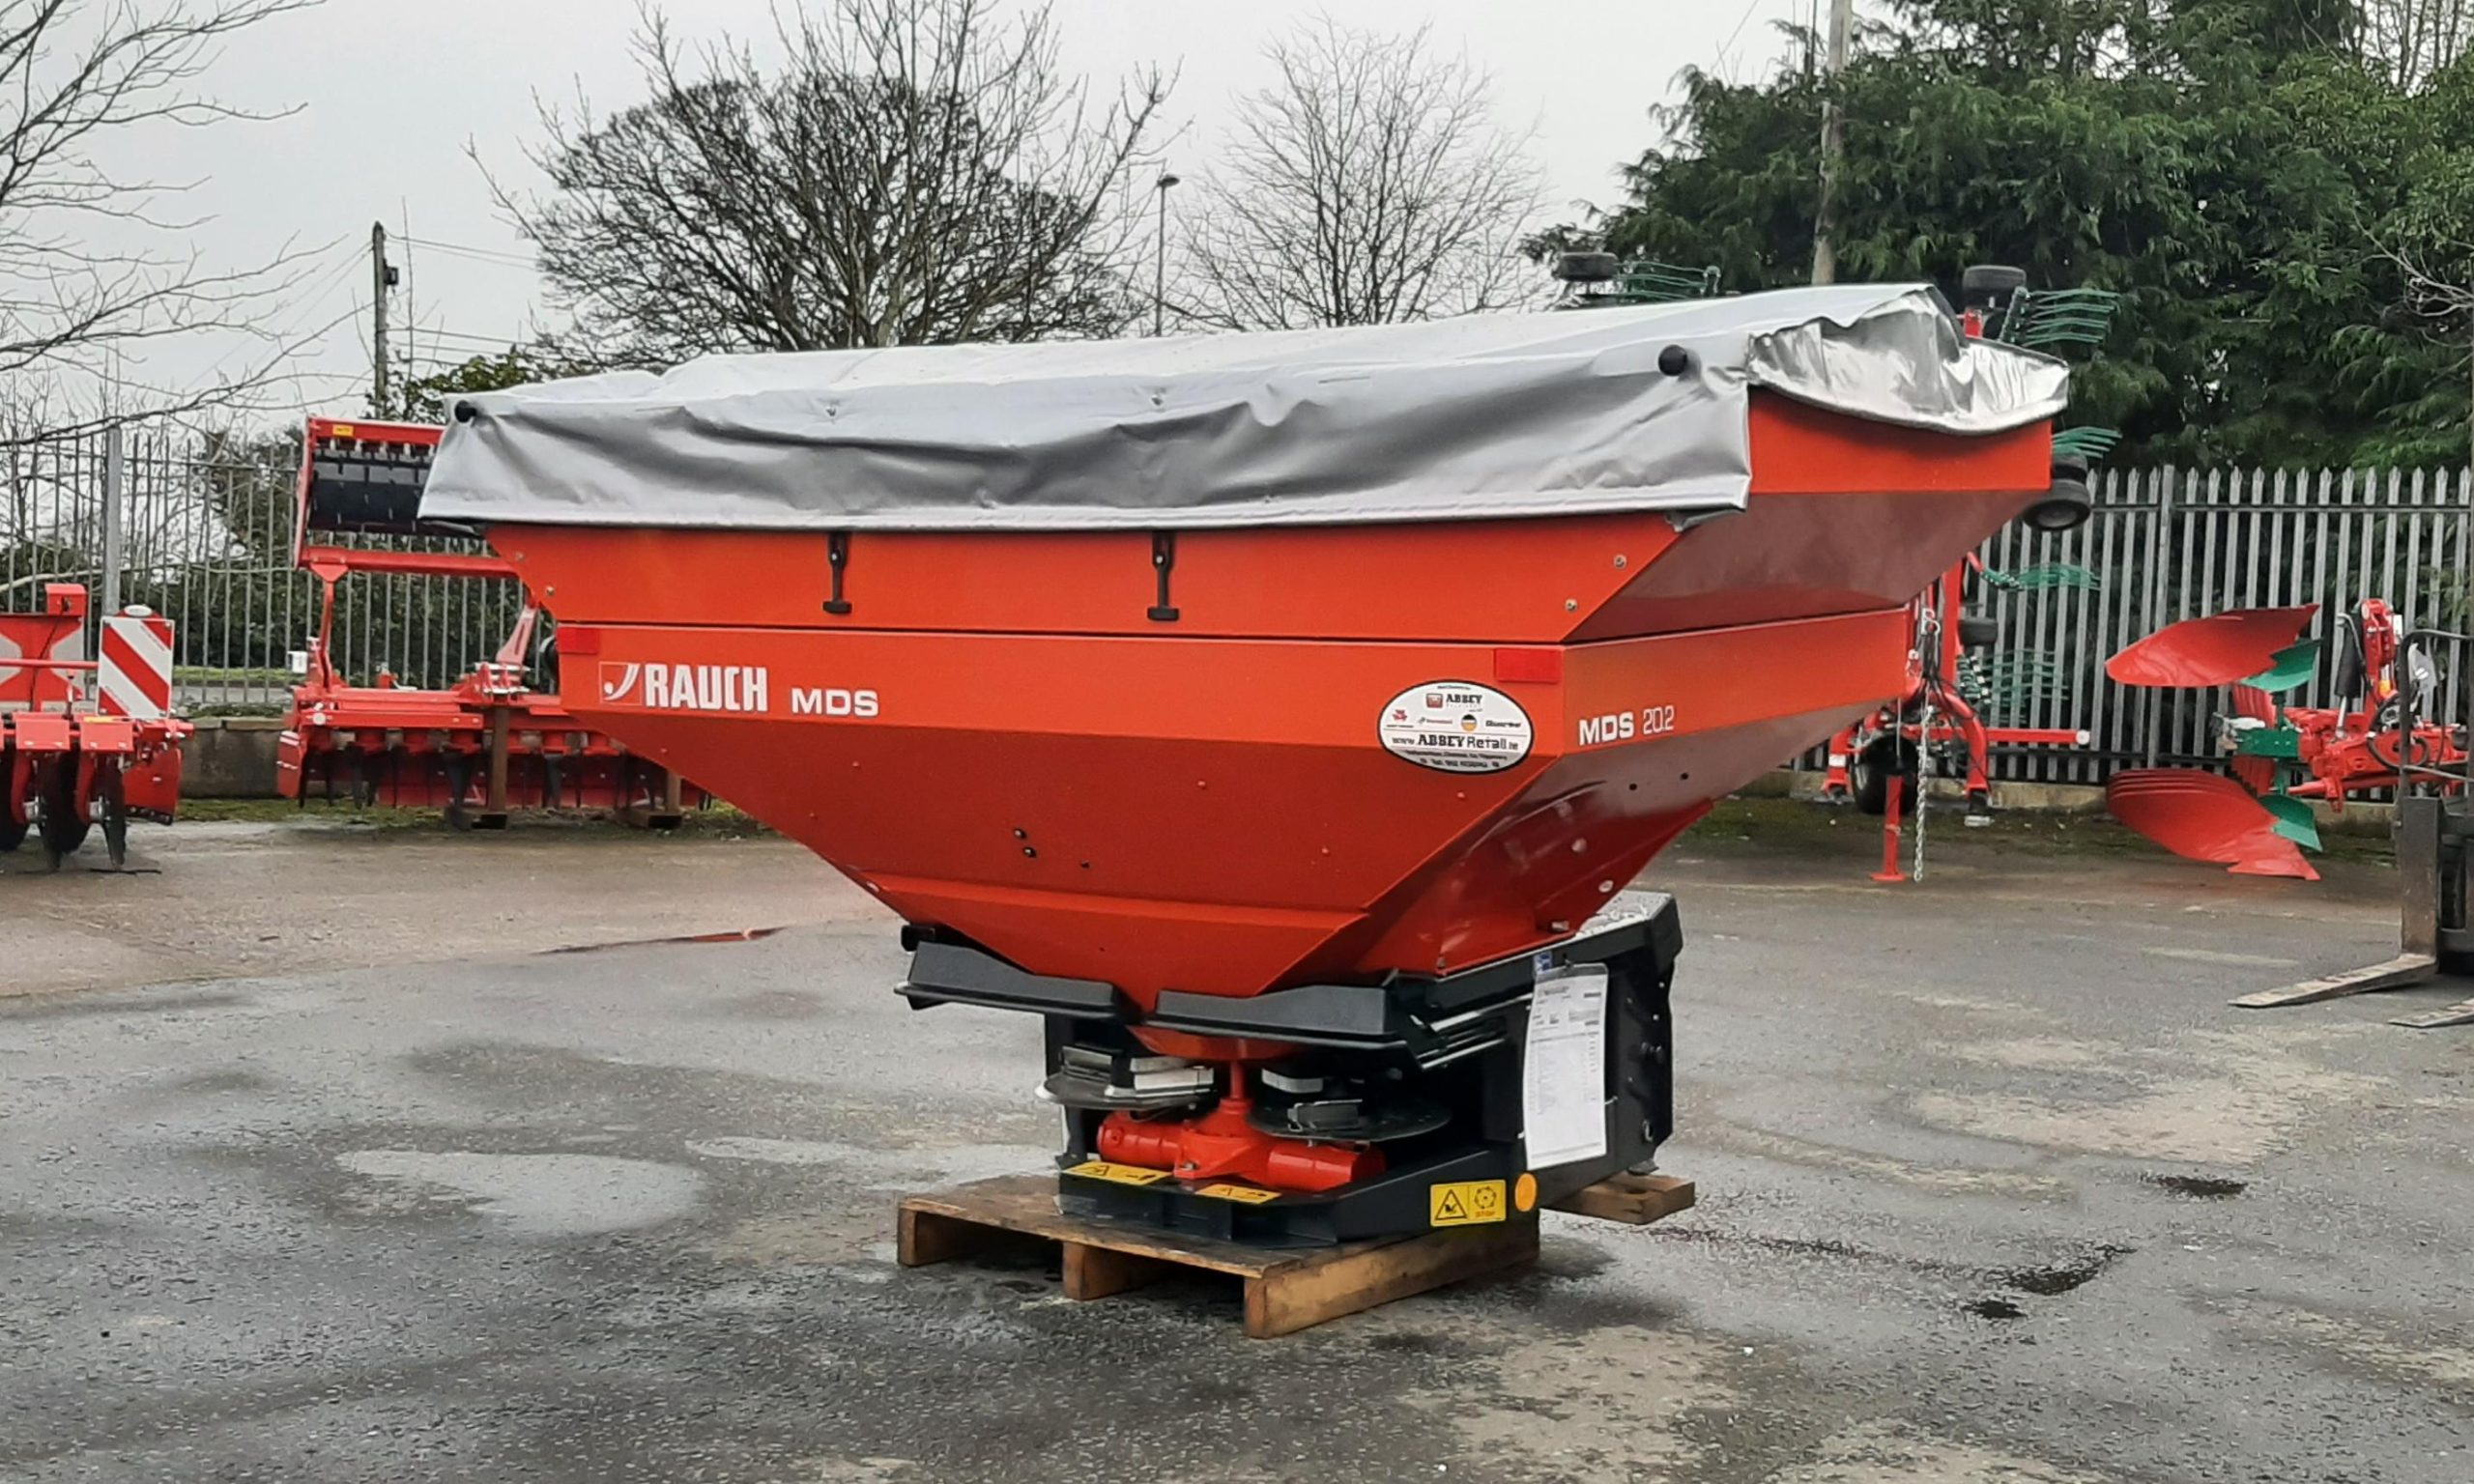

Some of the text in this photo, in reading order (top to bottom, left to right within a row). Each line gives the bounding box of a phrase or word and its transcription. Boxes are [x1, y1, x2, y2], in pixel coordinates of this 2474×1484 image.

[644, 663, 879, 717] RAUCH MDS
[1446, 694, 1482, 704] ABBEY
[1579, 712, 1633, 746] MDS
